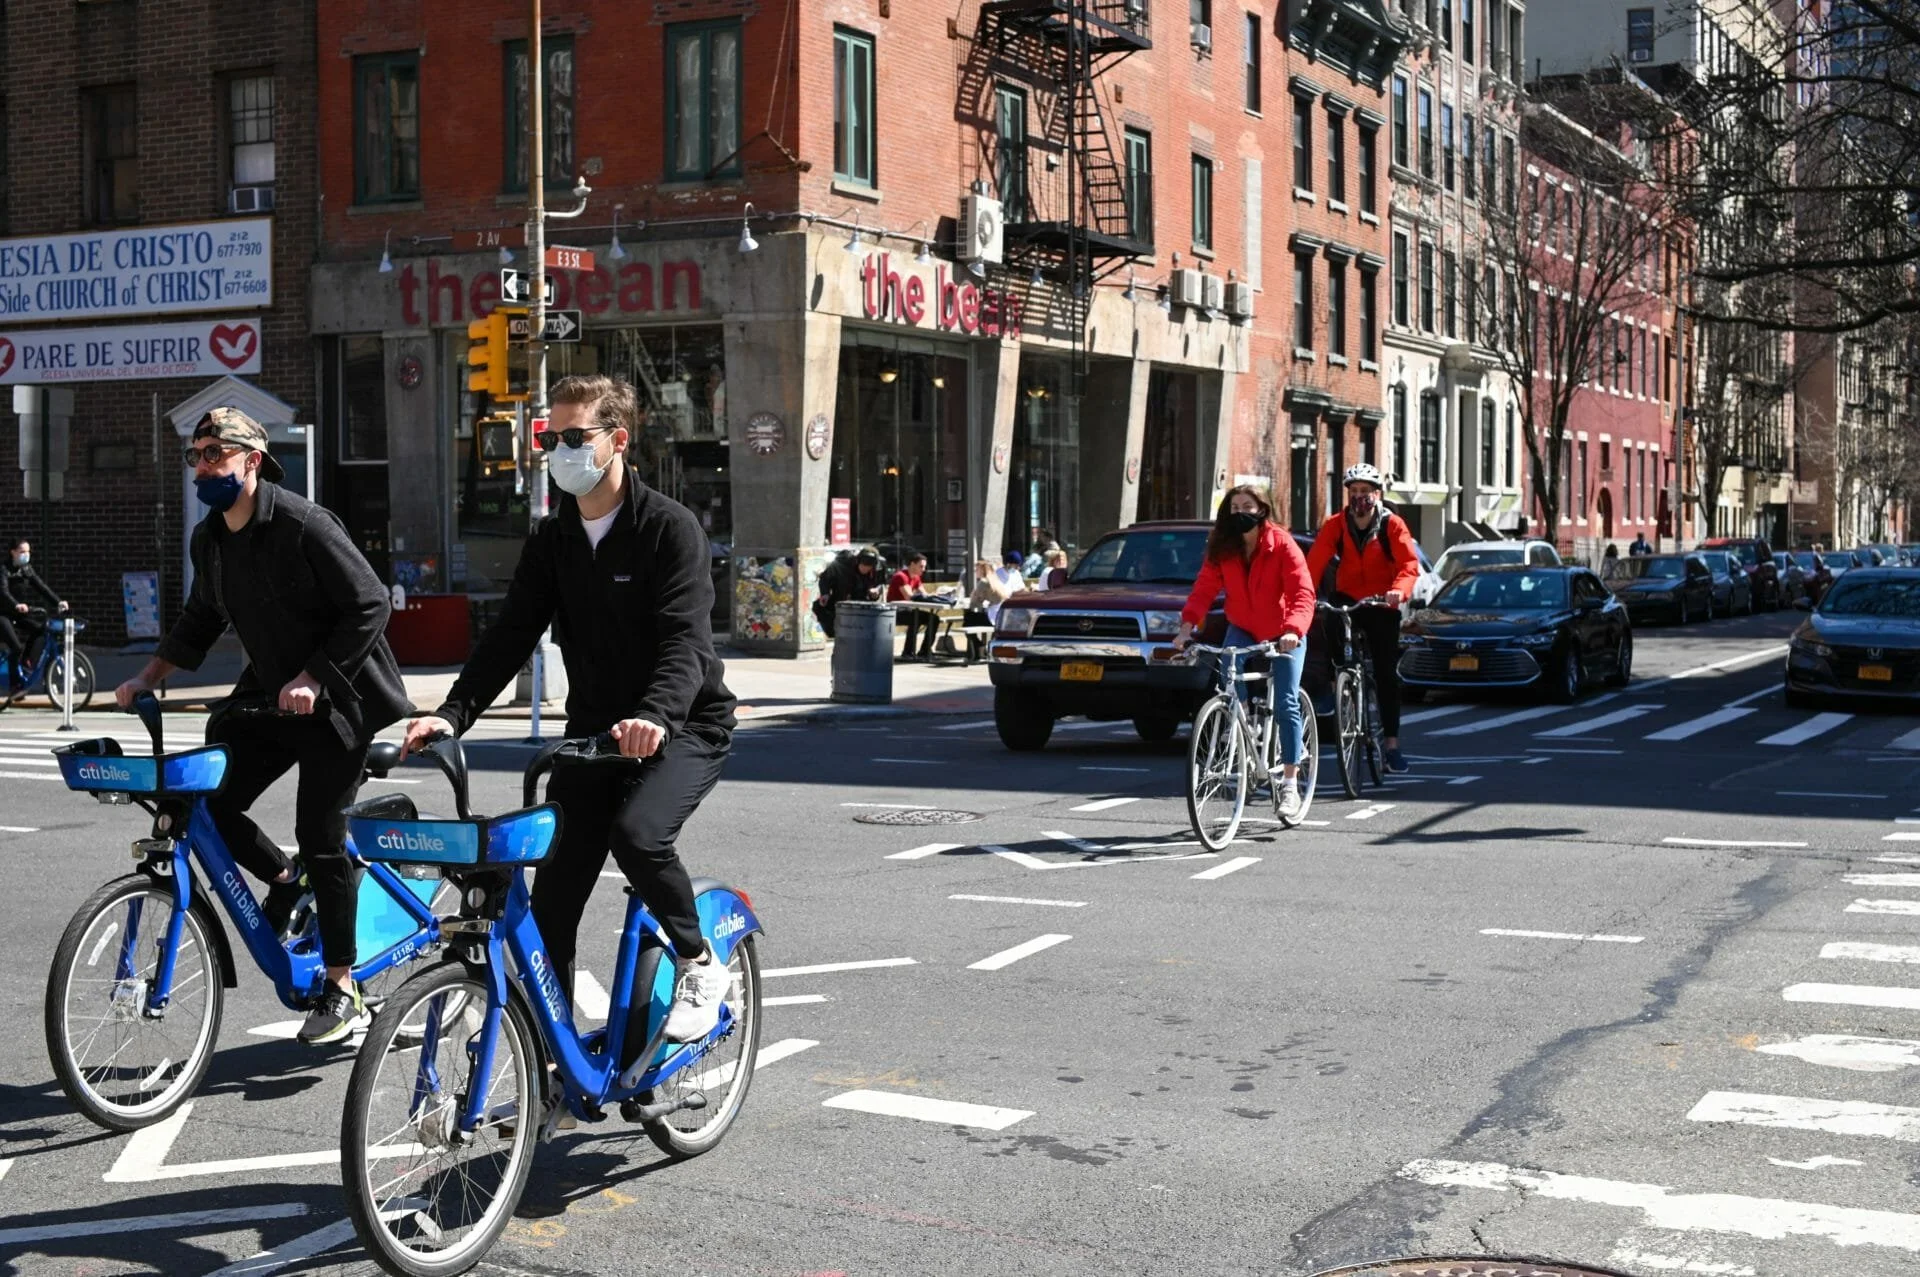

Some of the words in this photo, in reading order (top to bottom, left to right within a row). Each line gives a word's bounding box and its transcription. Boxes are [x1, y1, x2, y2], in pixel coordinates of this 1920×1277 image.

[230, 231, 248, 241] 212
[477, 232, 483, 246] 2
[0, 244, 60, 278] ESIA
[69, 240, 103, 273] DE
[114, 231, 213, 270] CRISTO
[217, 242, 262, 258] 677-7970
[558, 251, 562, 266] E
[564, 252, 570, 267] 3
[234, 270, 252, 279] 212
[36, 276, 117, 312] CHURCH
[122, 274, 141, 305] of
[147, 267, 225, 305] CHRIST
[224, 279, 267, 295] 677-6608
[400, 259, 504, 326] the
[864, 252, 925, 323] the
[516, 320, 529, 332] ON
[547, 320, 568, 333] WAY
[22, 343, 77, 370] PARE
[86, 341, 114, 367] DE
[123, 337, 201, 366] SUFRIR
[41, 369, 71, 380] IGLESIA
[73, 367, 115, 379] UNIVERSAL
[117, 366, 132, 376] DEL
[135, 366, 159, 375] REINO
[162, 365, 173, 374] DE
[391, 942, 415, 963] 41182
